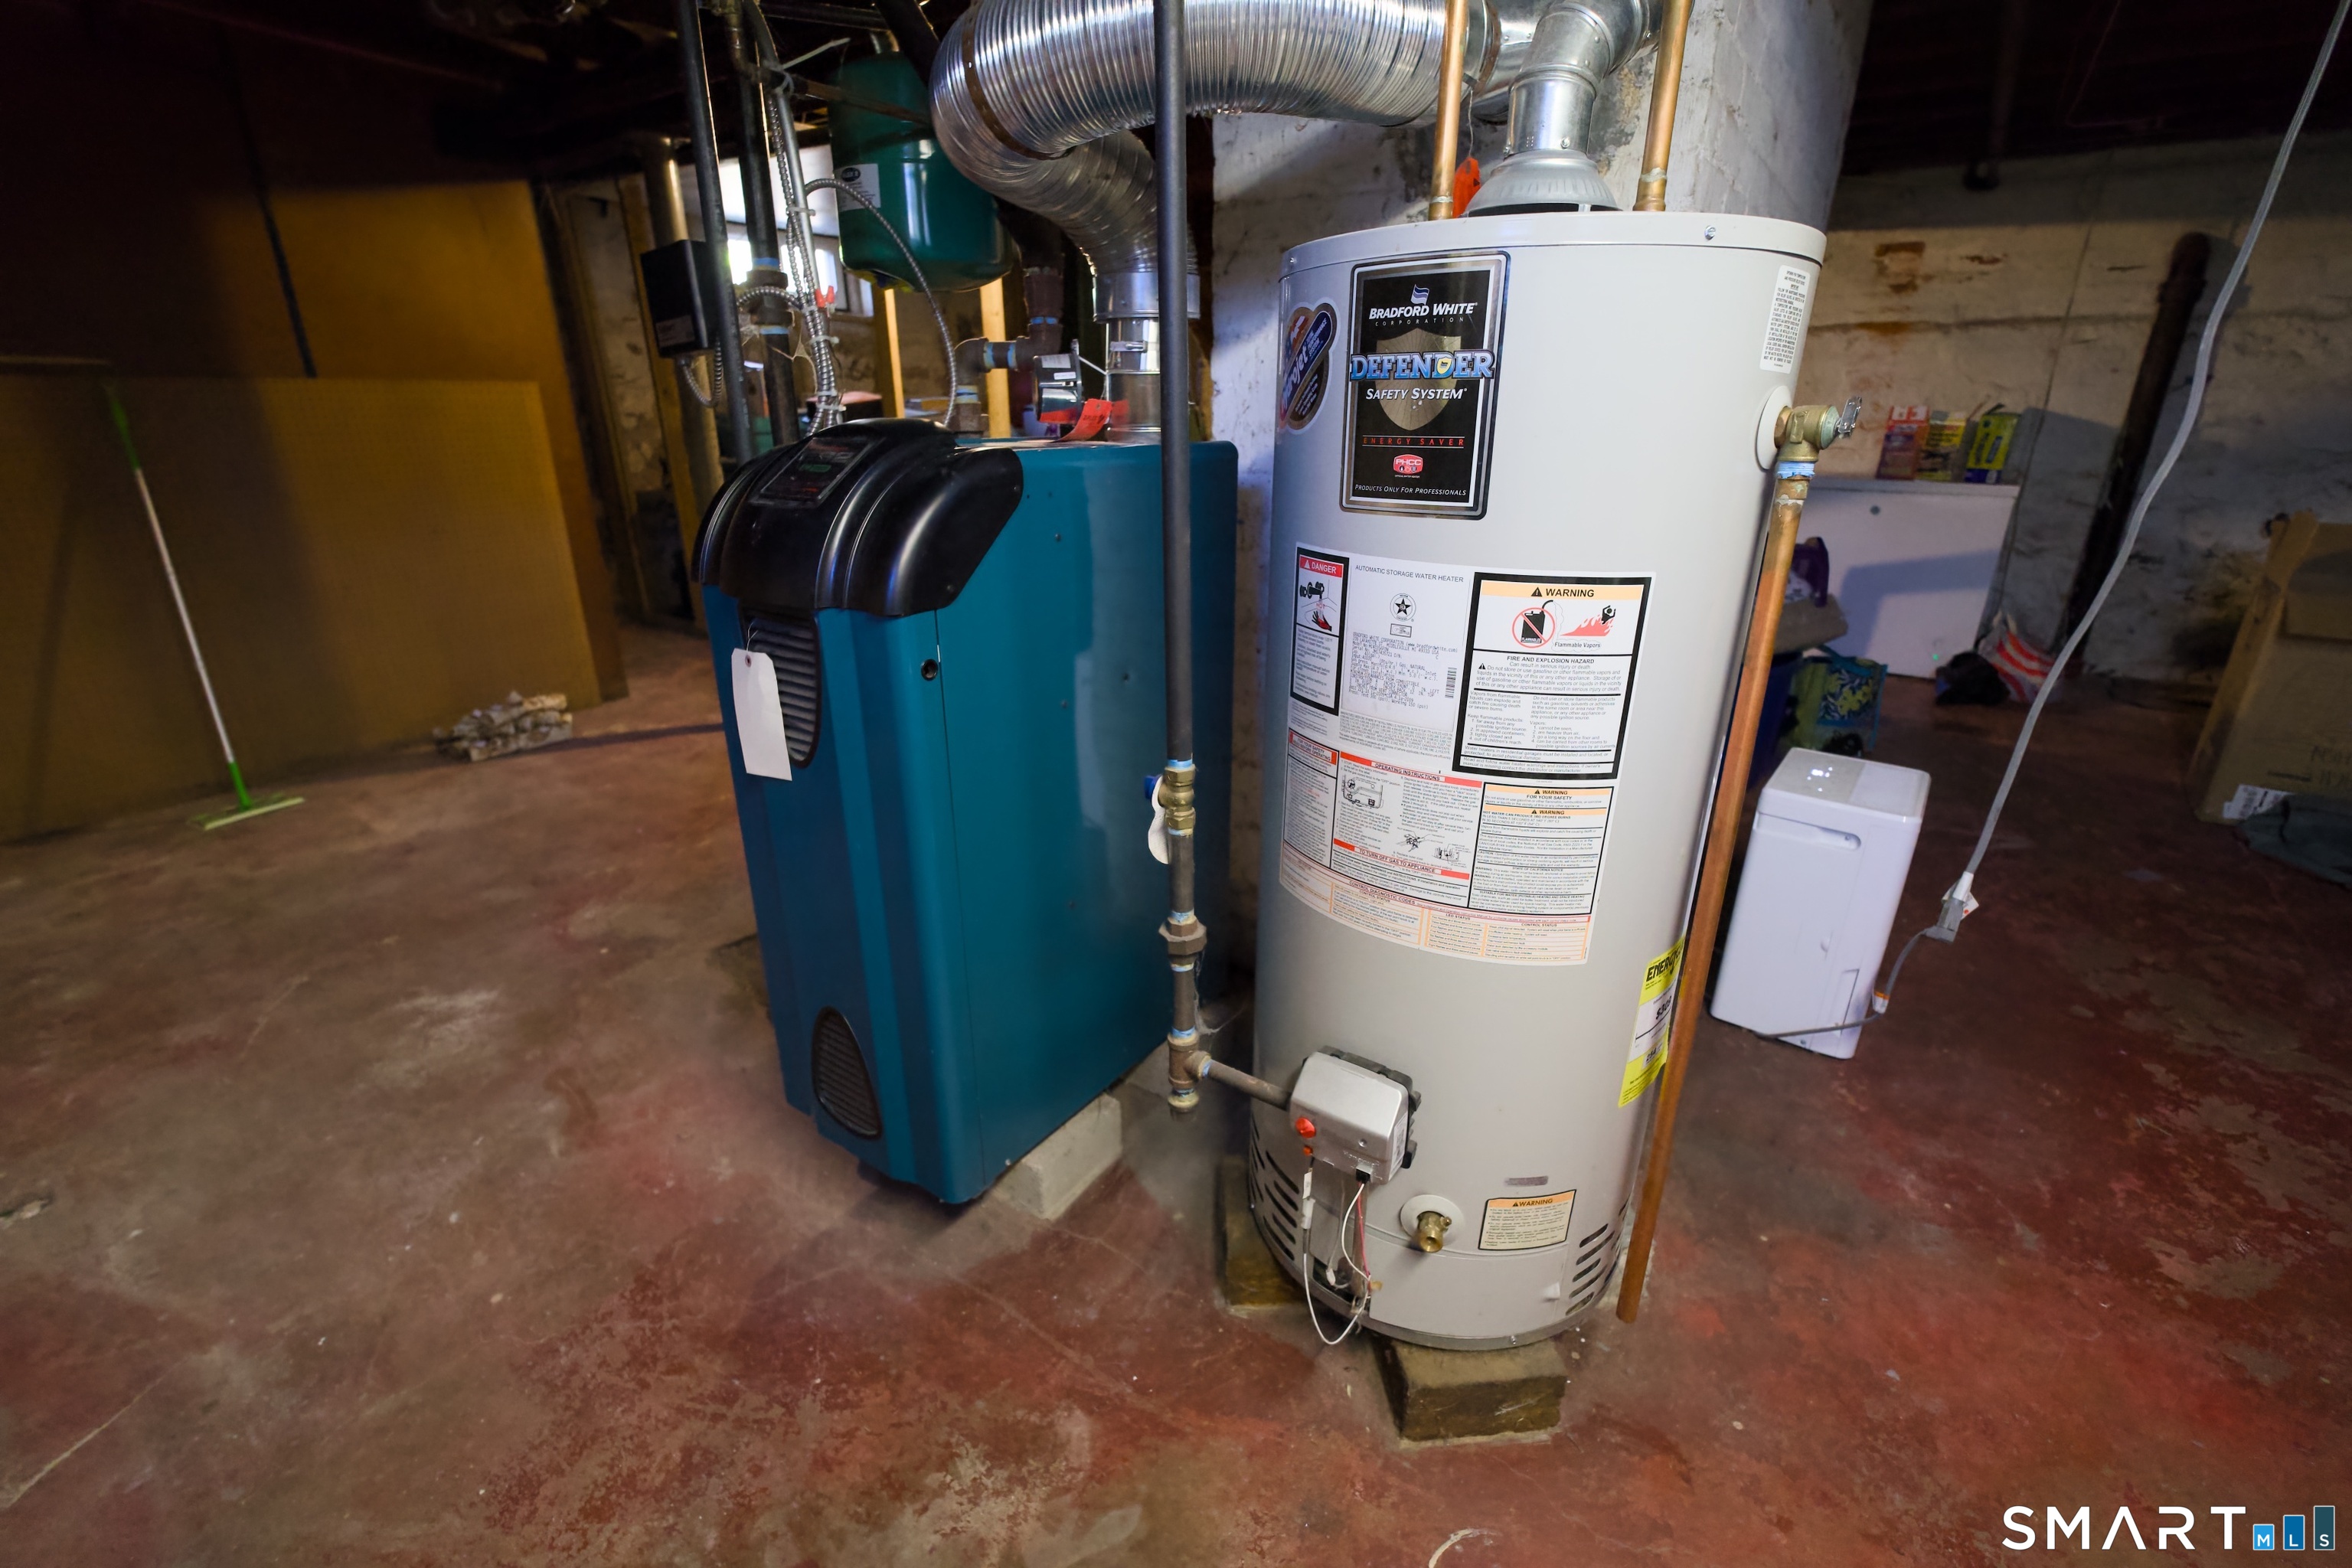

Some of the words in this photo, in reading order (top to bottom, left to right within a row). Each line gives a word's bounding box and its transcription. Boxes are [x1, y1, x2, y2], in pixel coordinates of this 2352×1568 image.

[1369, 305, 1429, 319] BRADFORD
[1375, 317, 1464, 326] CORPORATION
[1351, 350, 1495, 381] DEFENDER
[1366, 388, 1409, 400] SAFETY
[1415, 488, 1466, 496] PROFESSIONALS
[1312, 562, 1337, 574] DANGER
[1355, 565, 1385, 574] AUTOMATIC
[1387, 570, 1413, 578] STORAGE
[1546, 588, 1595, 597] WARNING
[1375, 763, 1402, 774] OPERATING
[1403, 769, 1440, 781] INSTRUCTIONS
[1407, 862, 1435, 873] APPLIANCE
[1349, 880, 1370, 892] CONTROL
[1370, 888, 1398, 900] DIAGNOSTIC
[1398, 897, 1416, 905] CODES
[1519, 1198, 1553, 1207] WARNING
